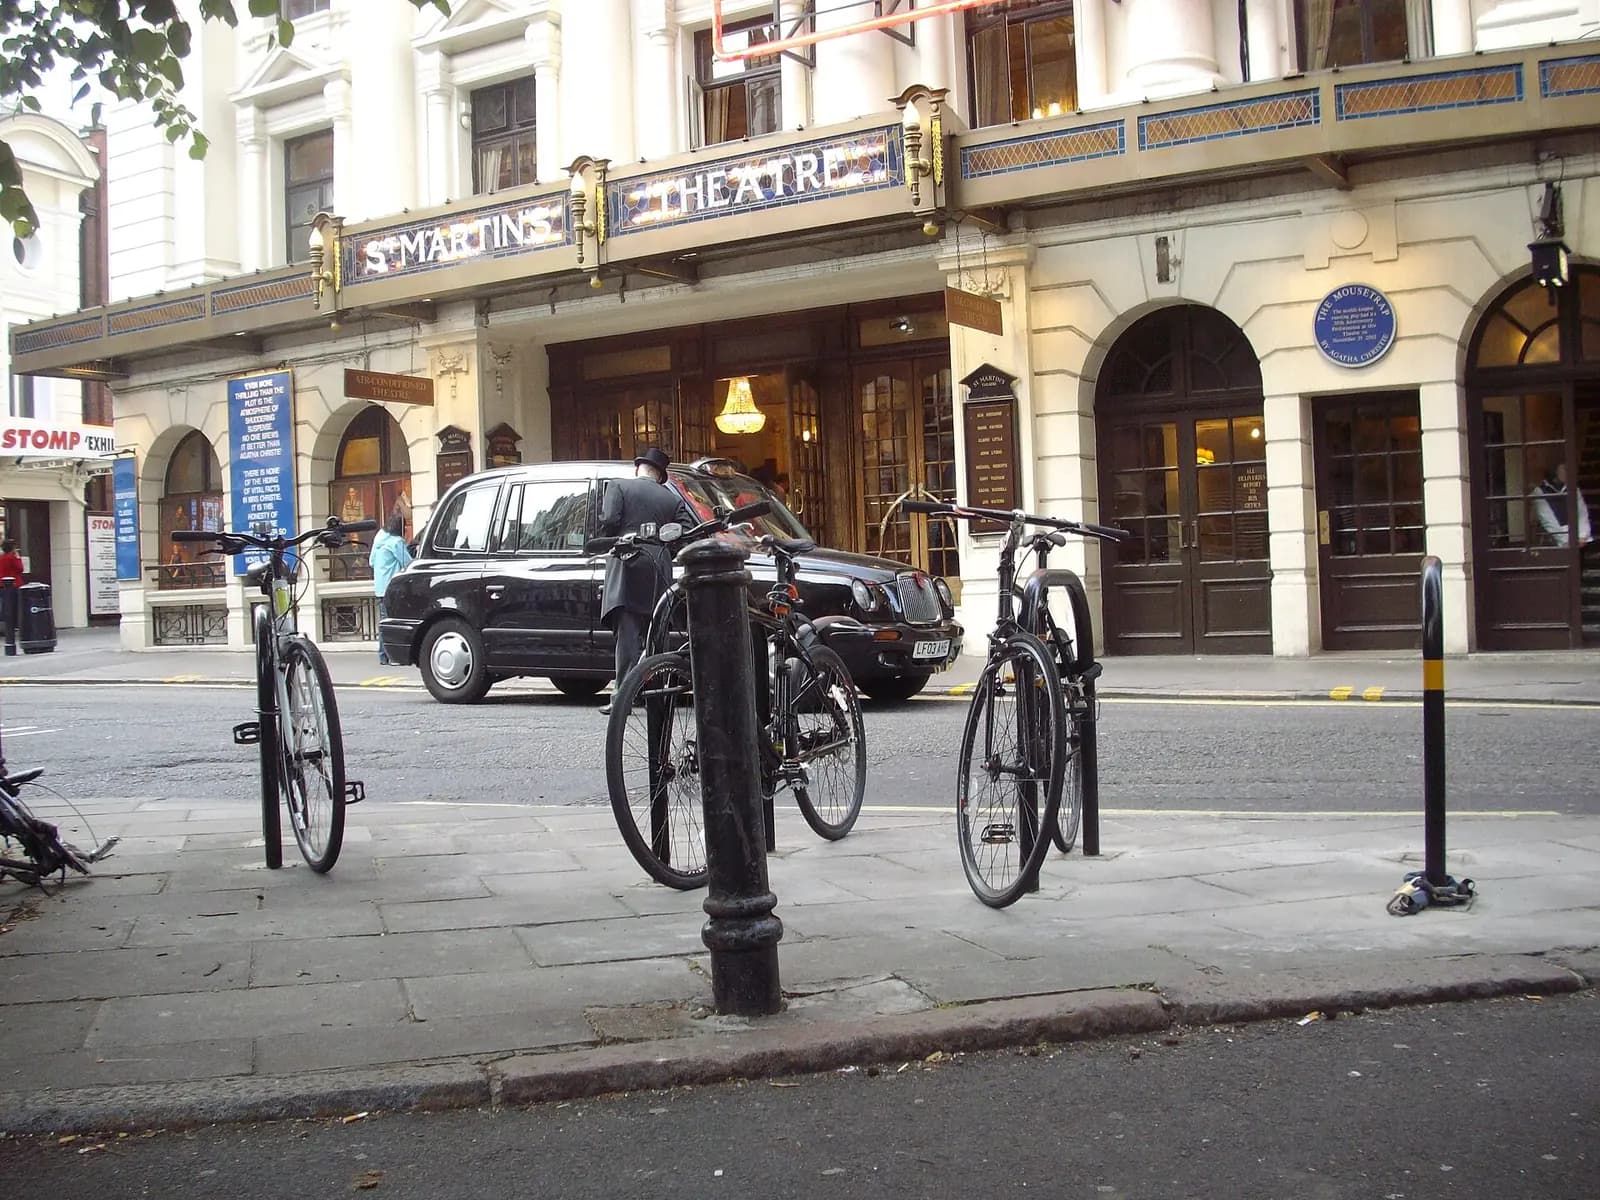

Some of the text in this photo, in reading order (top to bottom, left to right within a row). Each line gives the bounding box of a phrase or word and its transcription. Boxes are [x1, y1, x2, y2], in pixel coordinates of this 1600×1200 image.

[647, 147, 845, 212] THEATRE
[1318, 287, 1391, 321] THE MOUSETRAP
[1320, 334, 1390, 362] BY AGATHA CHRISTIE
[274, 386, 285, 394] THE
[244, 399, 257, 407] PLOT
[271, 404, 280, 412] OF
[2, 428, 81, 451] STOMP
[250, 432, 261, 441] ONE
[246, 442, 266, 450] BETTER
[239, 450, 259, 459] AGATHA
[243, 484, 280, 495] OF VITAL FACTS
[263, 502, 274, 510] THIS
[247, 510, 278, 520] HONESTY OF
[916, 642, 937, 655] LF03
